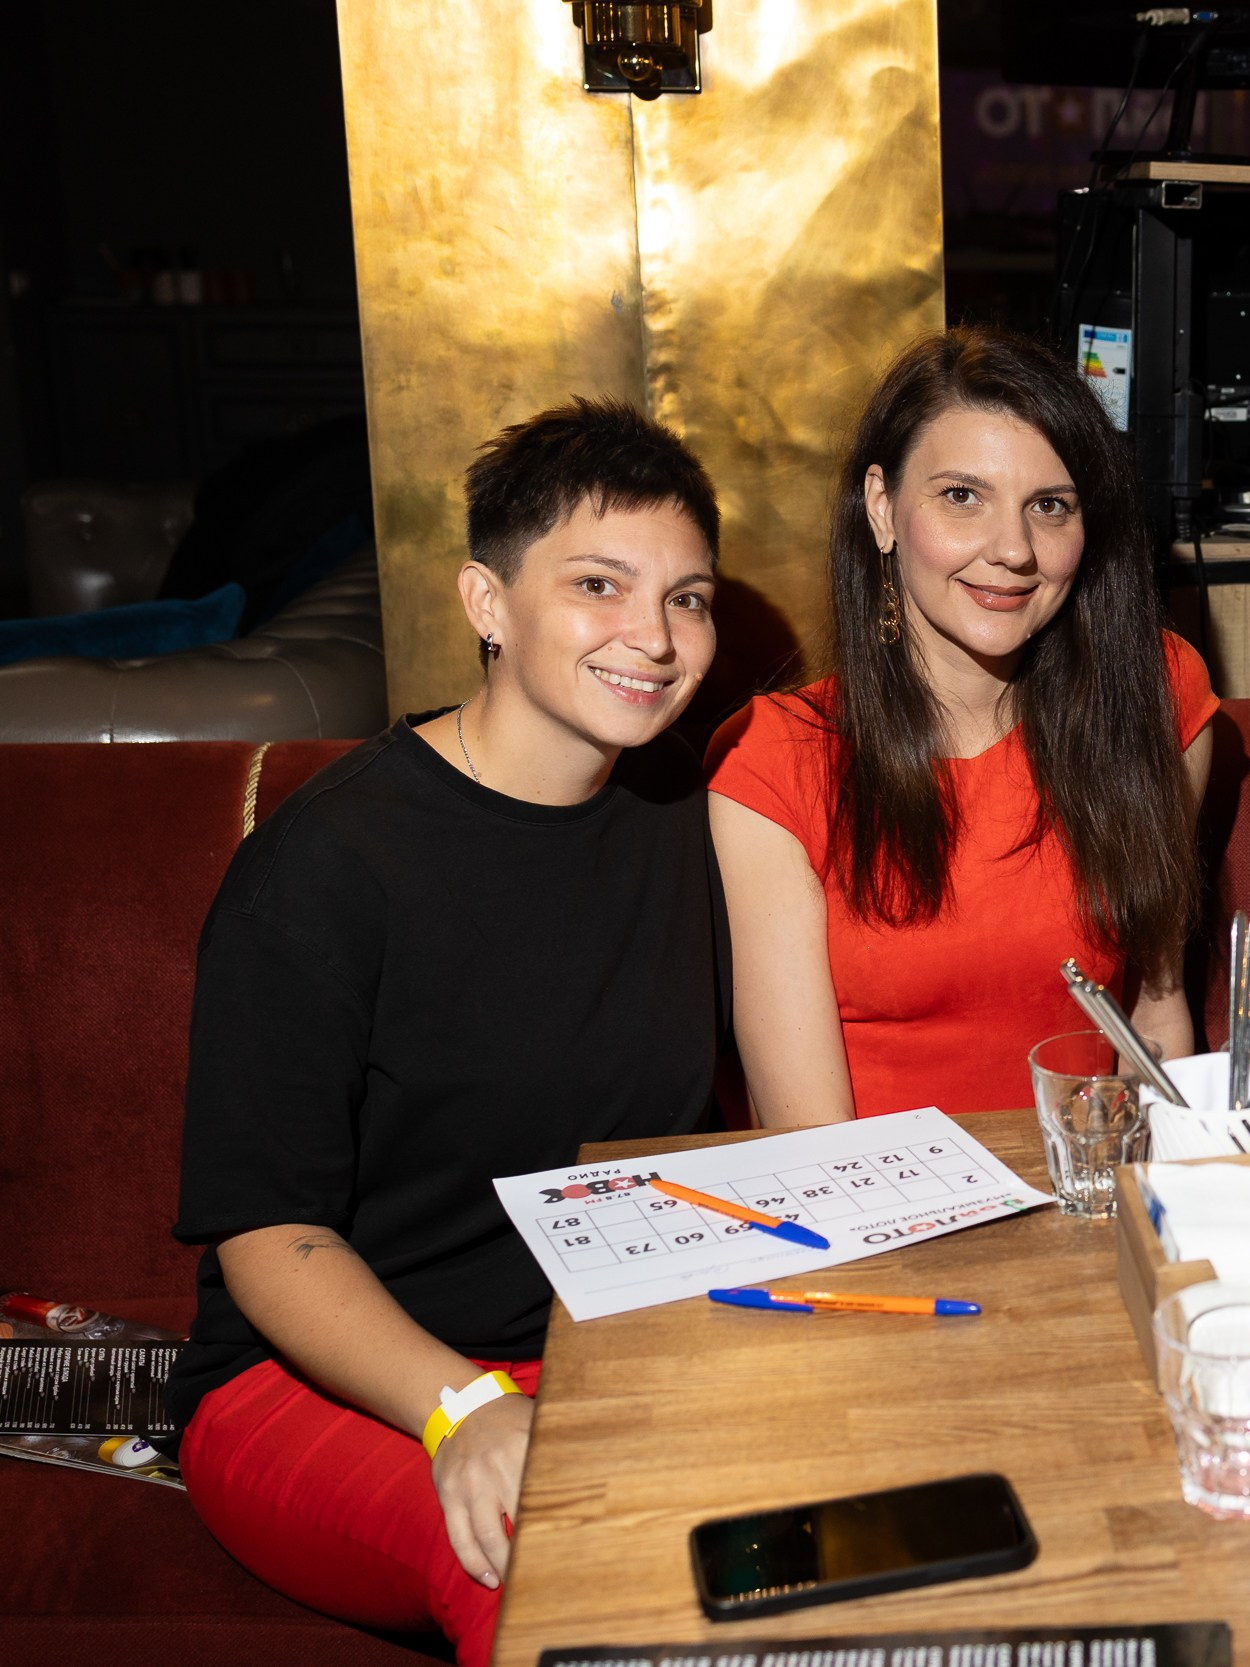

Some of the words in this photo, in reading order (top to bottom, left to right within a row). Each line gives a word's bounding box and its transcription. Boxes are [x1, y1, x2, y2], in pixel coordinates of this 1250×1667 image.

[929, 1145, 944, 1155] 9
[880, 1154, 904, 1164] 12
[833, 1161, 863, 1172] 24
[568, 1169, 621, 1180] РАДИО
[897, 1169, 920, 1180] 17
[962, 1174, 978, 1184] 2
[850, 1178, 876, 1188] 21
[803, 1186, 833, 1198] 38
[650, 1199, 678, 1211] 65
[755, 1197, 786, 1208] 46
[552, 1217, 581, 1230] 87
[724, 1221, 753, 1235] 59
[564, 1236, 591, 1247] 81
[675, 1232, 705, 1245] 60
[626, 1243, 656, 1255] 73
